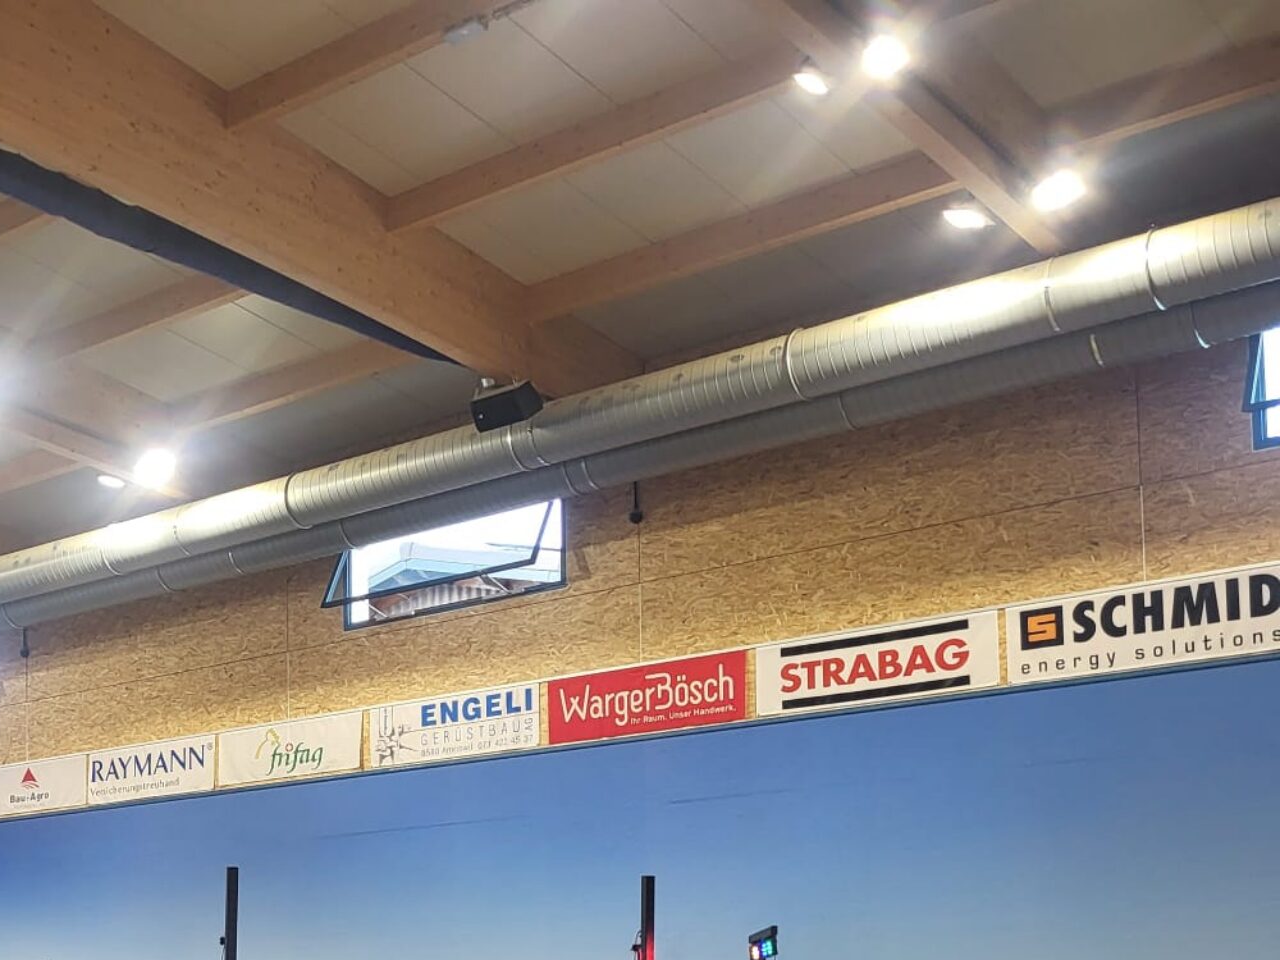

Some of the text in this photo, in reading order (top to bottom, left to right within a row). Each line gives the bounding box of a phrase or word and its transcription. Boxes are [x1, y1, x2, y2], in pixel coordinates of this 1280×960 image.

[1072, 574, 1280, 643] SCHMID
[780, 638, 970, 693] STRABAG
[1021, 629, 1280, 675] energy solutions
[421, 688, 532, 727] ENGELI
[643, 714, 667, 723] Raum.
[669, 711, 691, 720] Unser
[91, 744, 205, 782] RAYMANN
